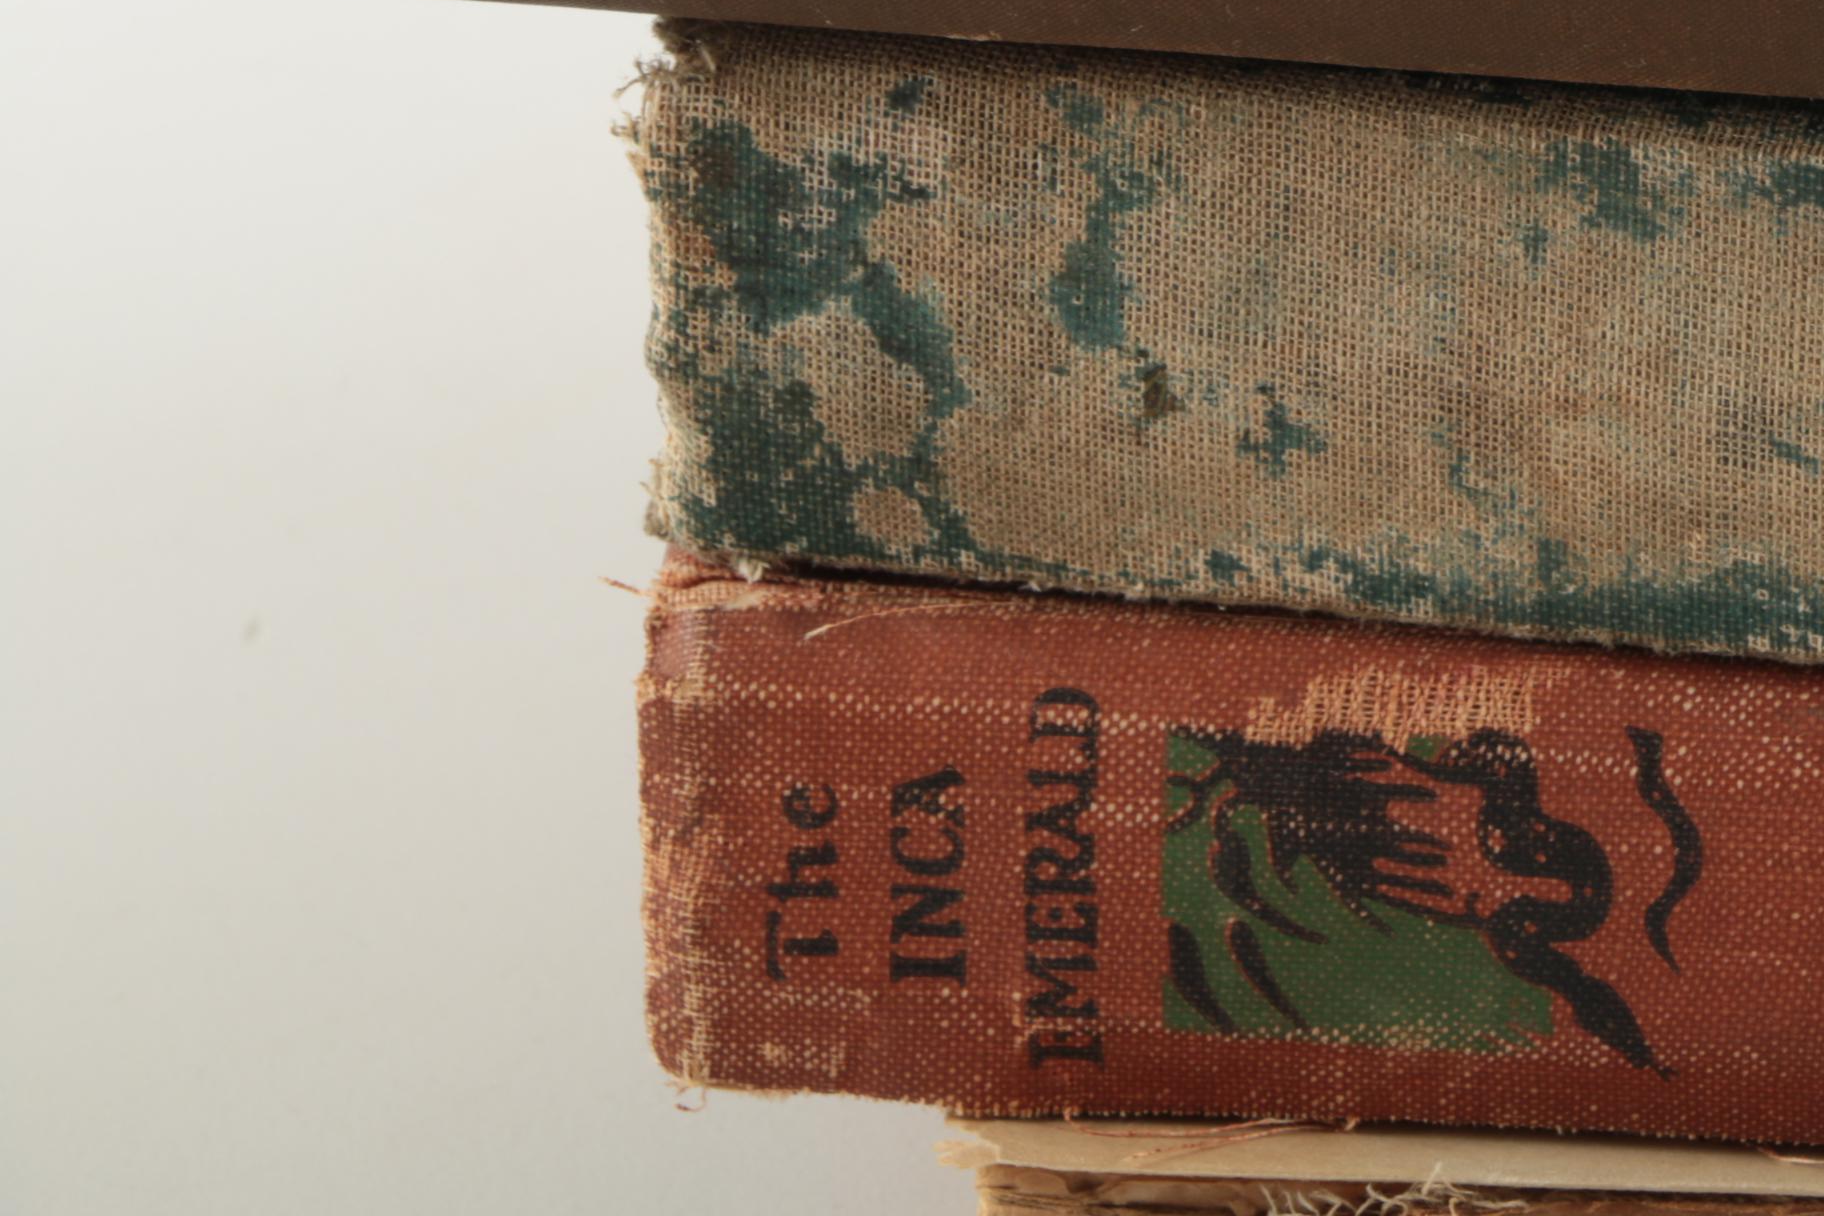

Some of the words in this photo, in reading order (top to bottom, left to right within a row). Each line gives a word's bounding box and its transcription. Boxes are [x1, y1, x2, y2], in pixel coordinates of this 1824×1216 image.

[764, 781, 840, 982] The
[889, 764, 968, 986] INCA
[1024, 686, 1105, 1068] EMERALD
